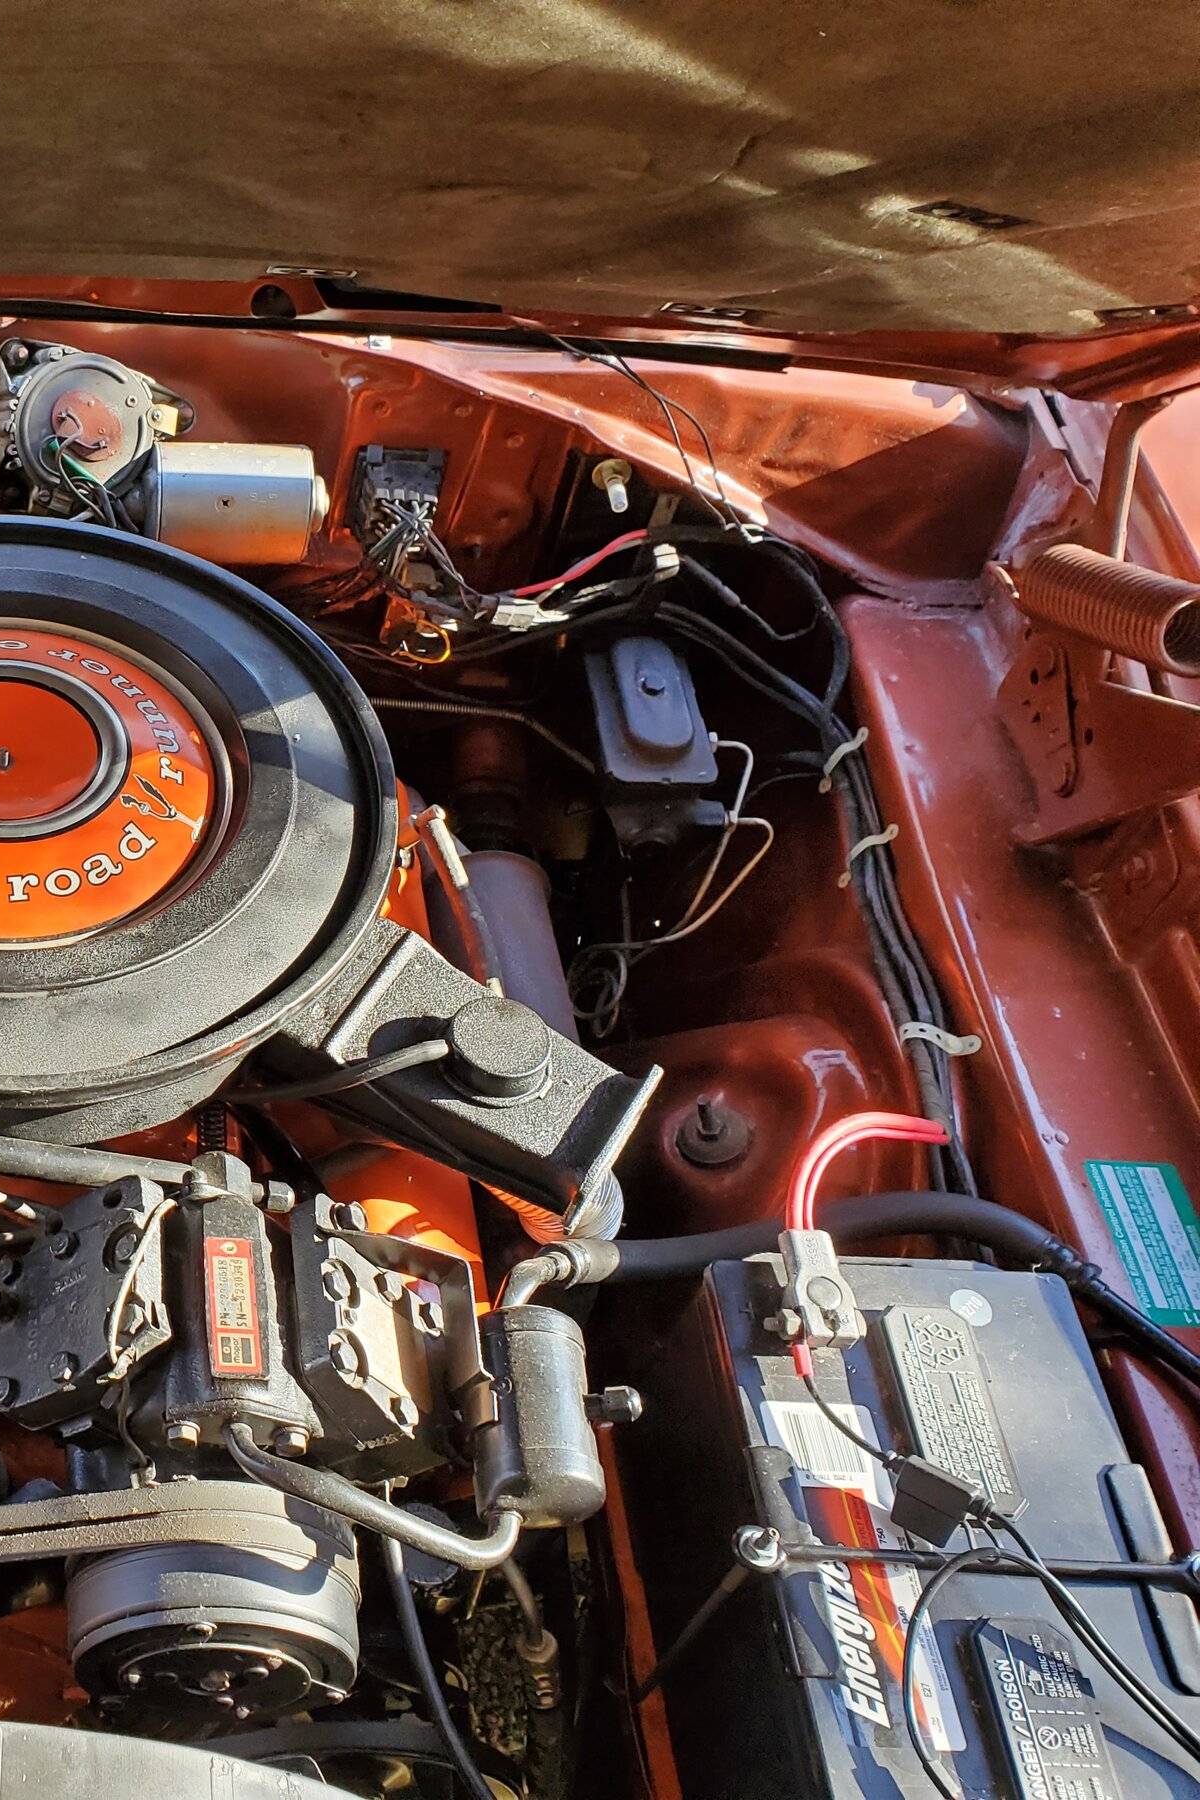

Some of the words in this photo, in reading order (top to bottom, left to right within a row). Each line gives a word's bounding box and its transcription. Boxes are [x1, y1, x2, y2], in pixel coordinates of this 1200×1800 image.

[47, 647, 185, 786] runner
[7, 820, 158, 902] road
[232, 1337, 241, 1364] mopar
[875, 1526, 887, 1544] 750
[818, 1550, 892, 1729] Energize
[1031, 1634, 1044, 1652] ACID
[996, 1658, 1027, 1722] POISON
[1038, 1655, 1058, 1698] SULFURIC
[1055, 1682, 1065, 1697] CAN
[1061, 1734, 1073, 1746] NO
[1069, 1726, 1082, 1753] SPARKS
[1077, 1726, 1090, 1753] FLAMES
[1084, 1723, 1098, 1753] SMOKING
[1019, 1739, 1048, 1800] ANGER
